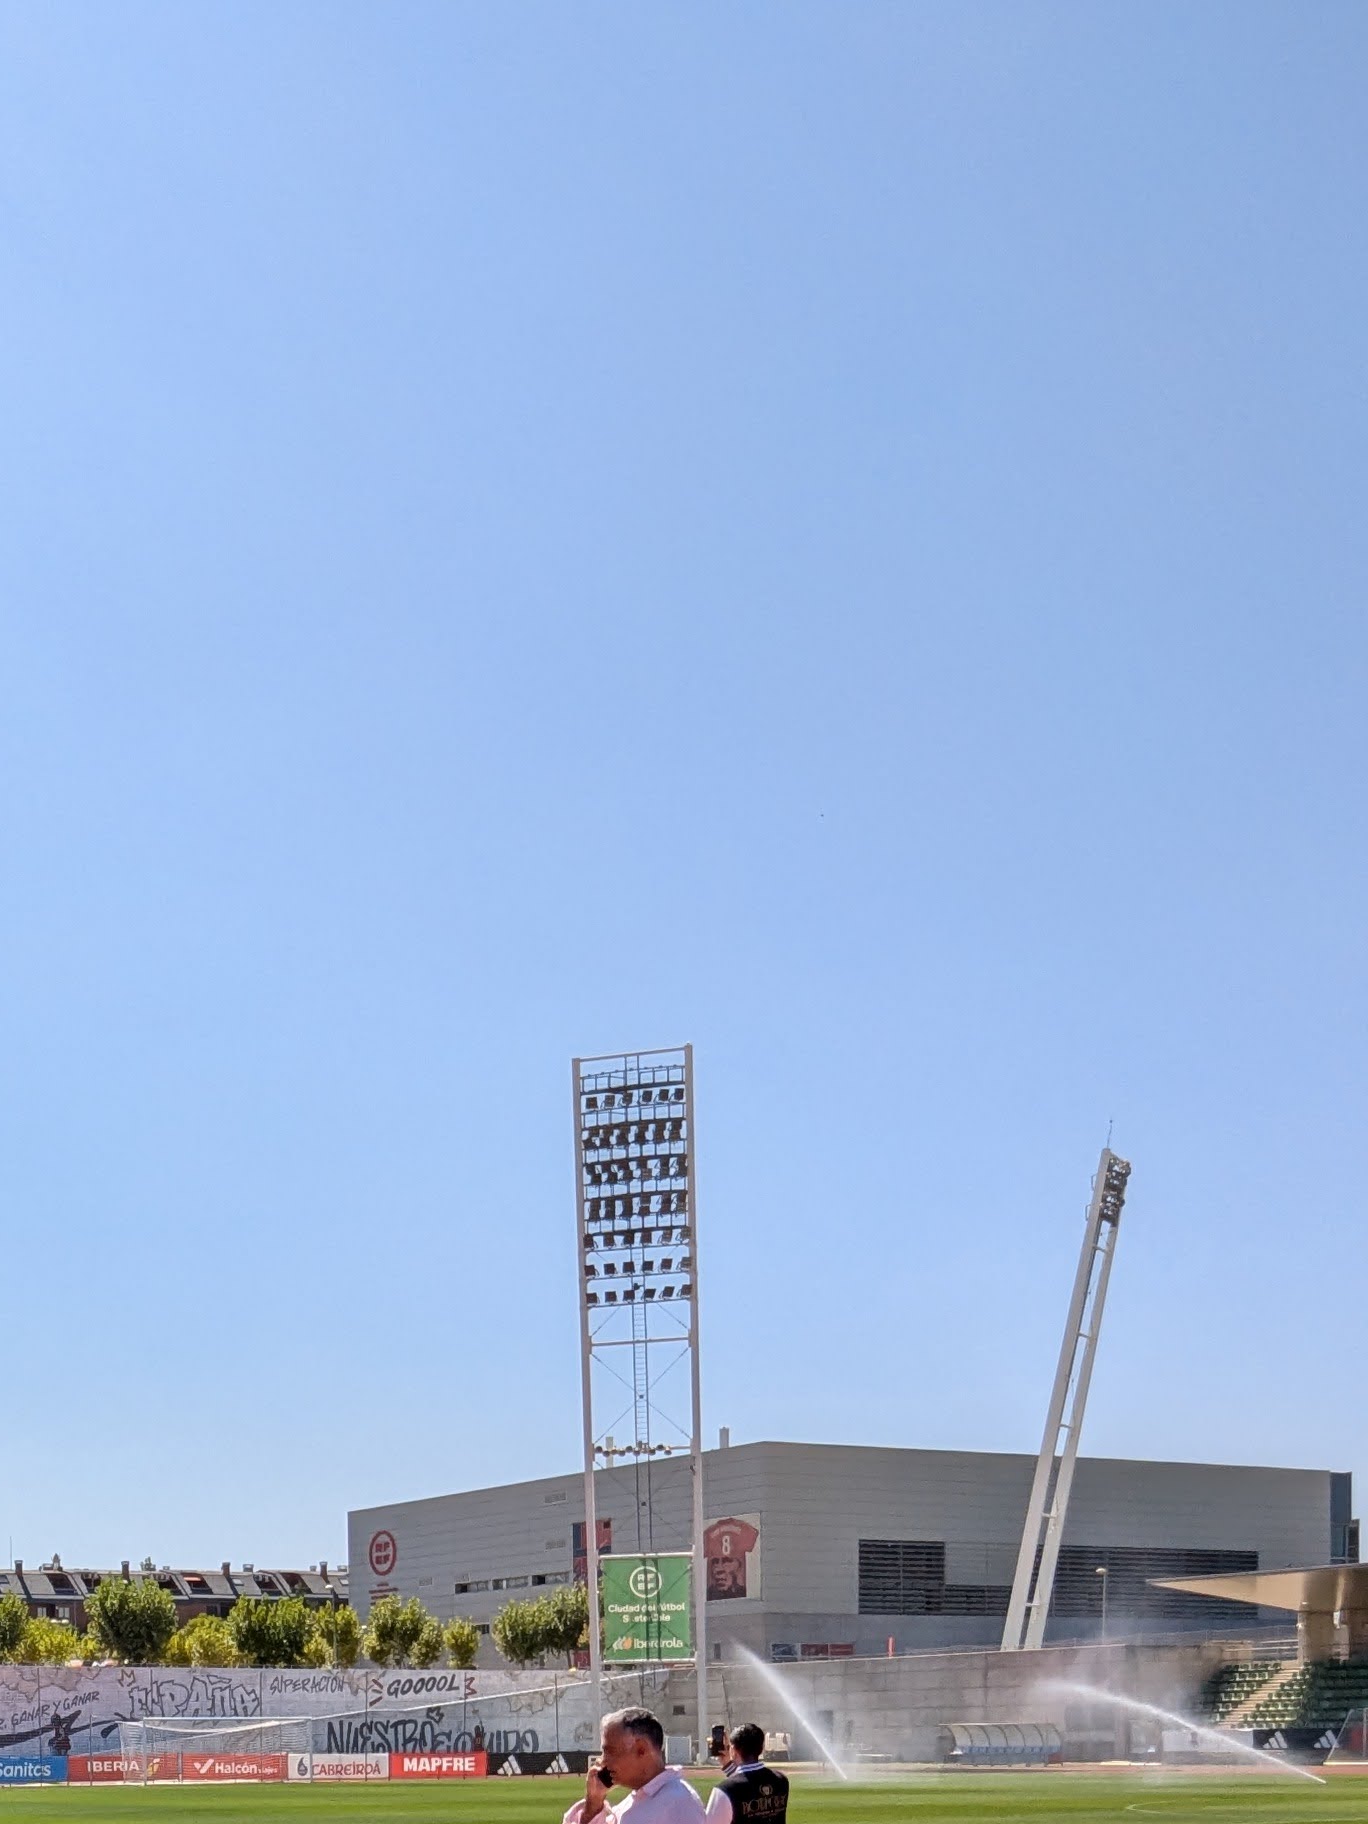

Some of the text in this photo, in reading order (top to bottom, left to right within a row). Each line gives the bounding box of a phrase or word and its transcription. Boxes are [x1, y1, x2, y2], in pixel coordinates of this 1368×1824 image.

[722, 1535, 731, 1555] 8
[607, 1603, 640, 1613] Ciudad
[657, 1602, 685, 1612] útbol
[387, 1674, 460, 1698] GOOOOL
[11, 1704, 51, 1726] GANAR
[52, 1701, 61, 1714] Y
[62, 1691, 100, 1711] GANAR
[87, 1760, 139, 1773] IBERIA
[215, 1761, 257, 1774] Halcón
[403, 1757, 475, 1772] MAPFRE
